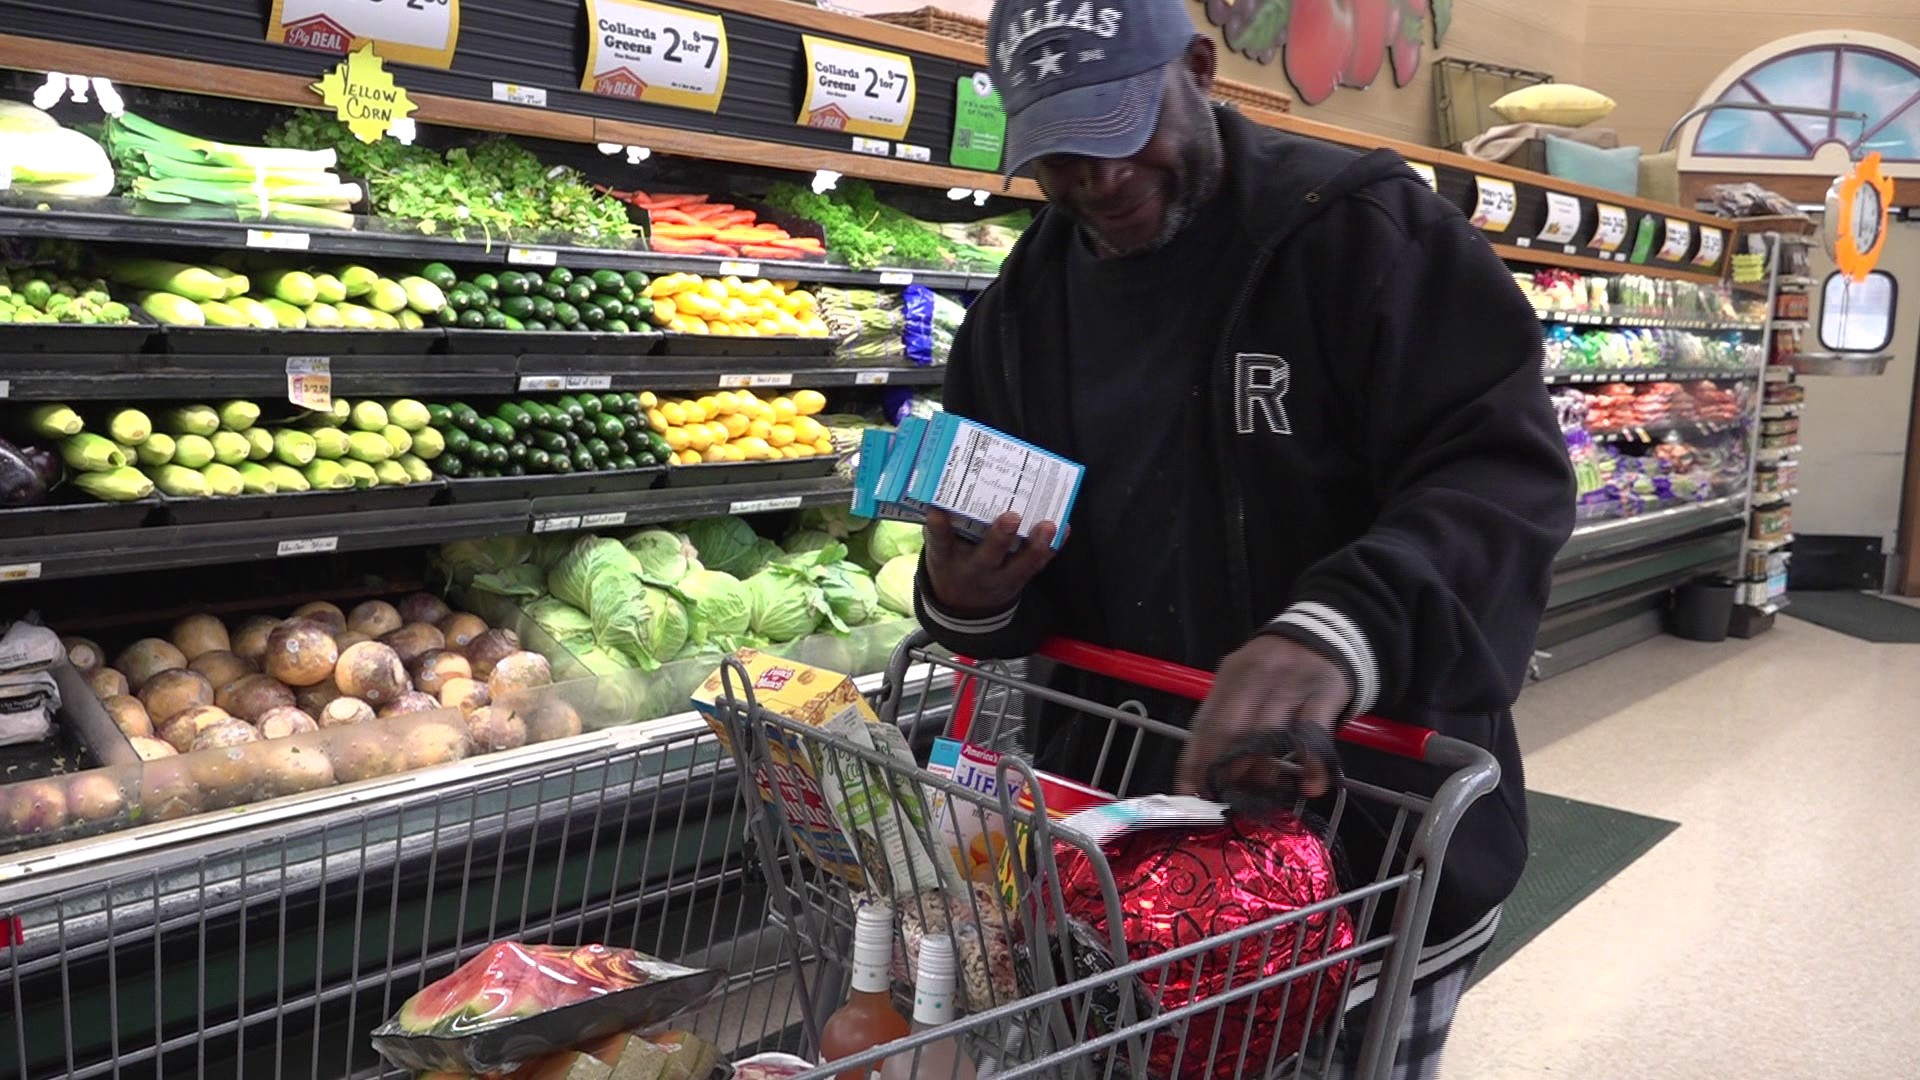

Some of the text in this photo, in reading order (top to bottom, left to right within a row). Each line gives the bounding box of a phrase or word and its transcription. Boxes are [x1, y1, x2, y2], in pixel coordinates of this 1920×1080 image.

[310, 31, 343, 50] DEAL
[598, 18, 657, 41] Collards
[603, 34, 653, 55] Greens
[662, 27, 683, 63] 2
[682, 39, 702, 53] for
[814, 61, 860, 80] Collards
[341, 65, 397, 104] YELLOW
[613, 80, 637, 97] DEAL
[818, 75, 857, 92] Greens
[864, 67, 880, 99] 2
[346, 97, 392, 122] CORN
[1234, 353, 1293, 434] R
[962, 744, 998, 763] America's
